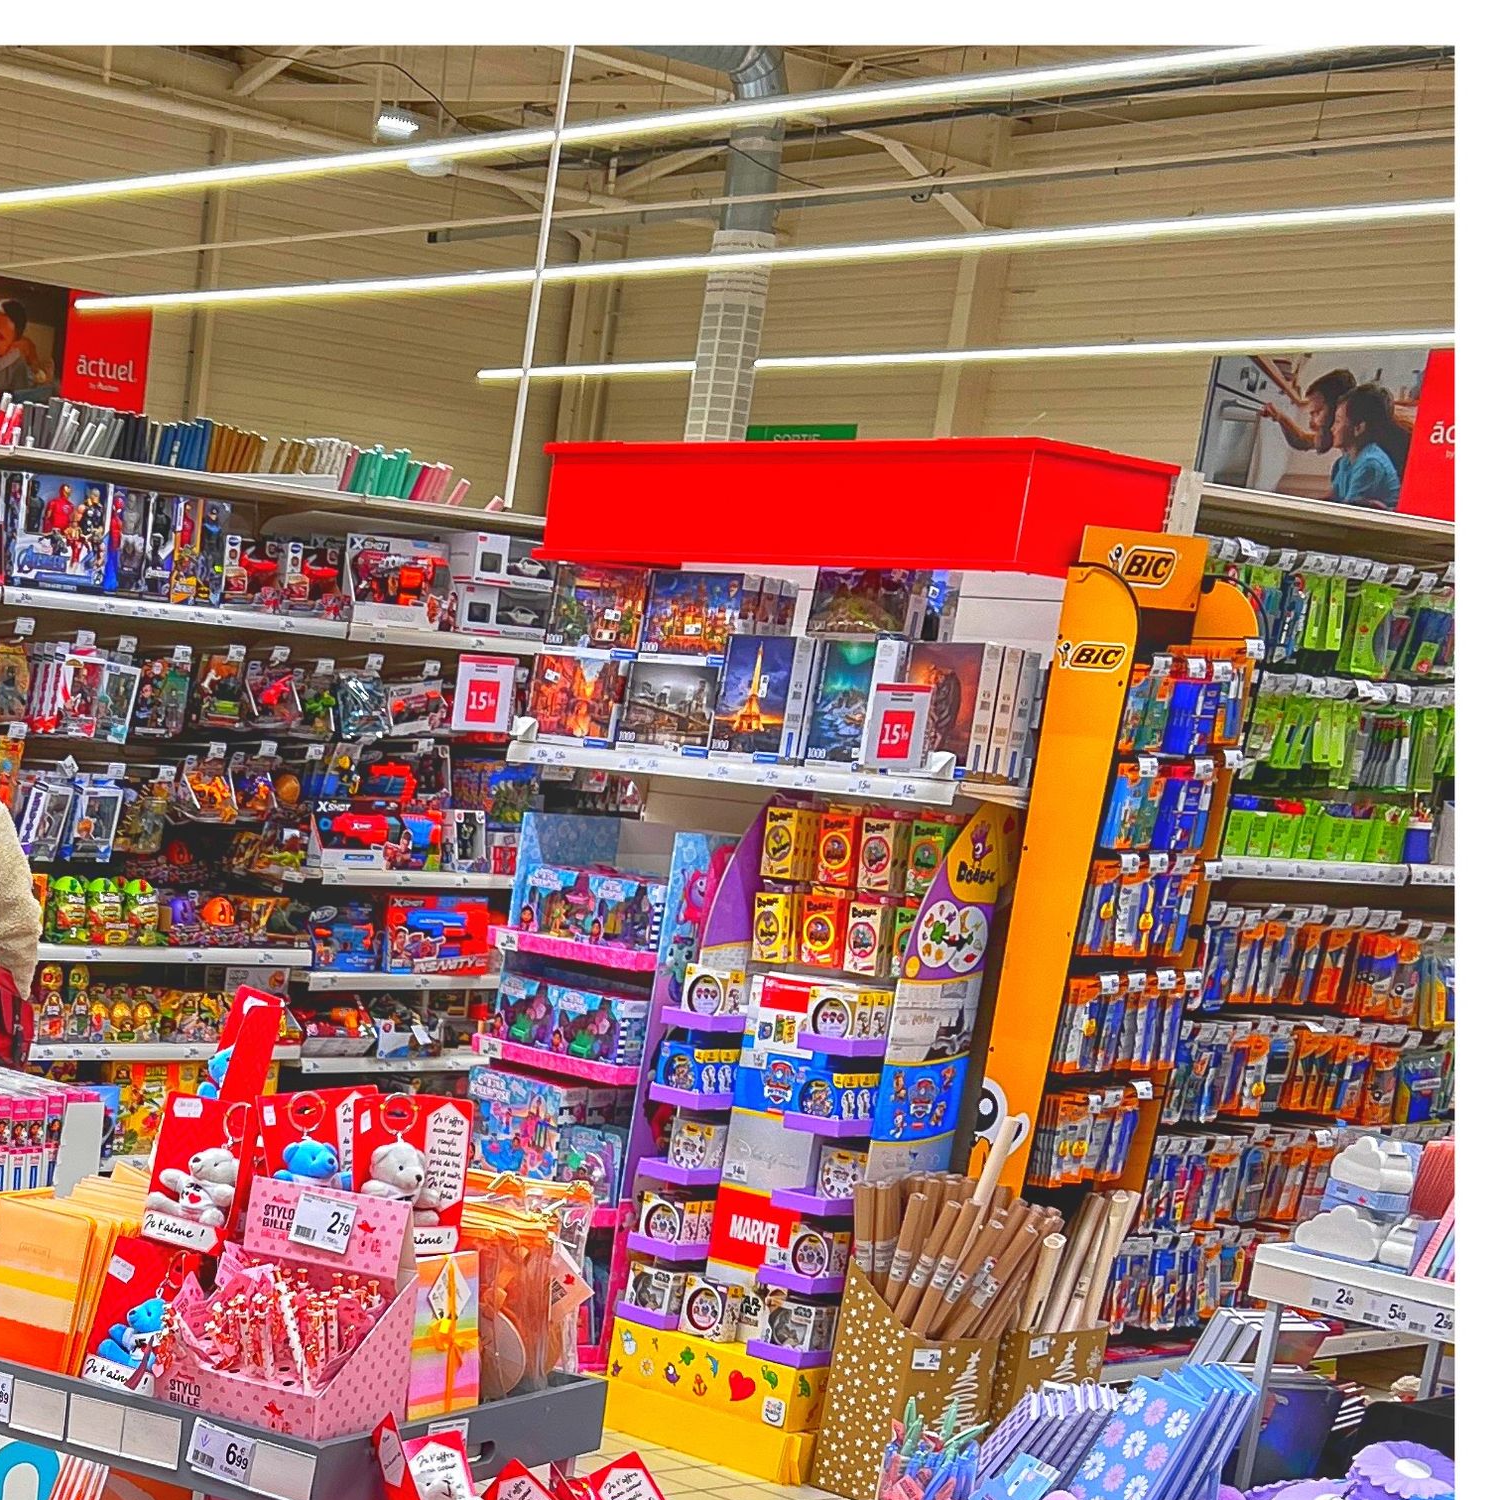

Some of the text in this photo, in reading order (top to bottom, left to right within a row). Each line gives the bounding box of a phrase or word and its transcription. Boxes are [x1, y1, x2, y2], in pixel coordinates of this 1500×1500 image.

[263, 1203, 295, 1220] STYLO
[144, 1213, 157, 1230] Je
[262, 1217, 292, 1231] BILLE
[729, 1213, 780, 1247] MARVEL
